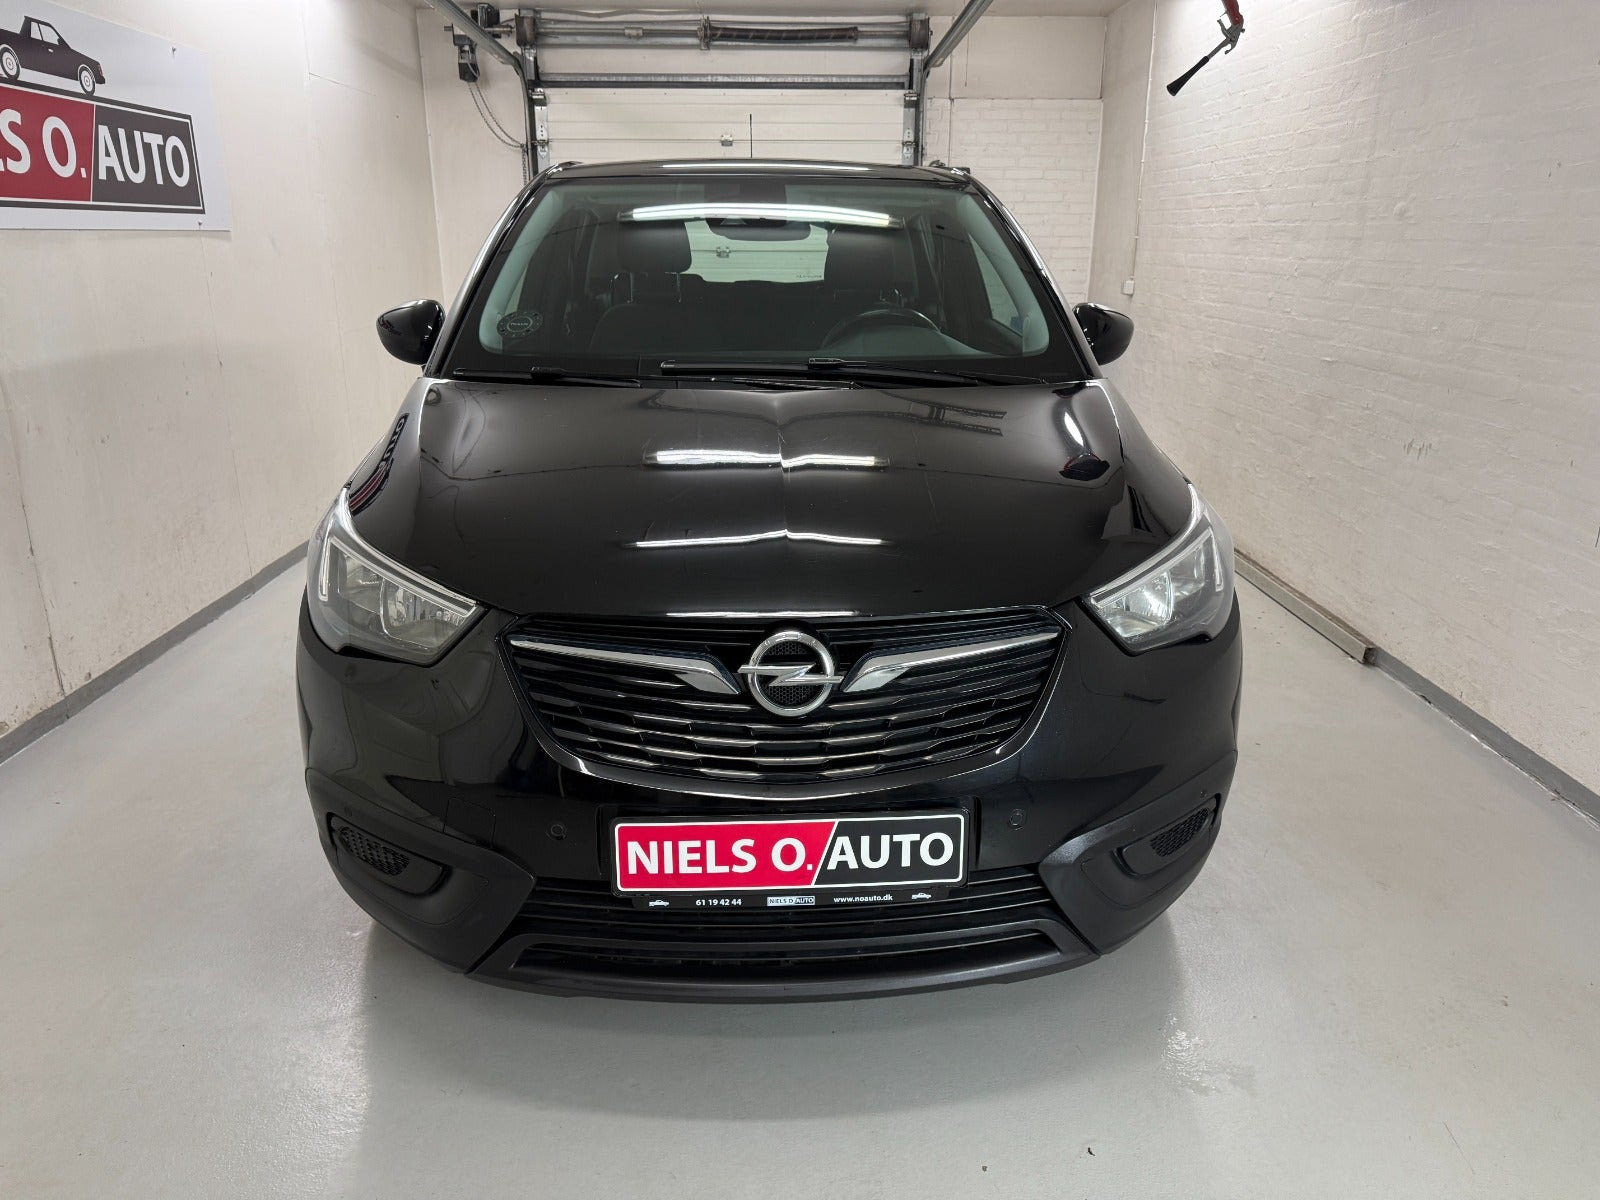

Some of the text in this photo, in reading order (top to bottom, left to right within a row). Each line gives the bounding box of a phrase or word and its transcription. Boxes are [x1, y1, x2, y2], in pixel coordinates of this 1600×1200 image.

[0, 108, 190, 187] S O. AUTO
[626, 832, 954, 875] NIELS O. AUTO
[719, 898, 730, 906] 42
[795, 896, 814, 904] AUTO
[833, 893, 893, 903] www.noauto.dk
